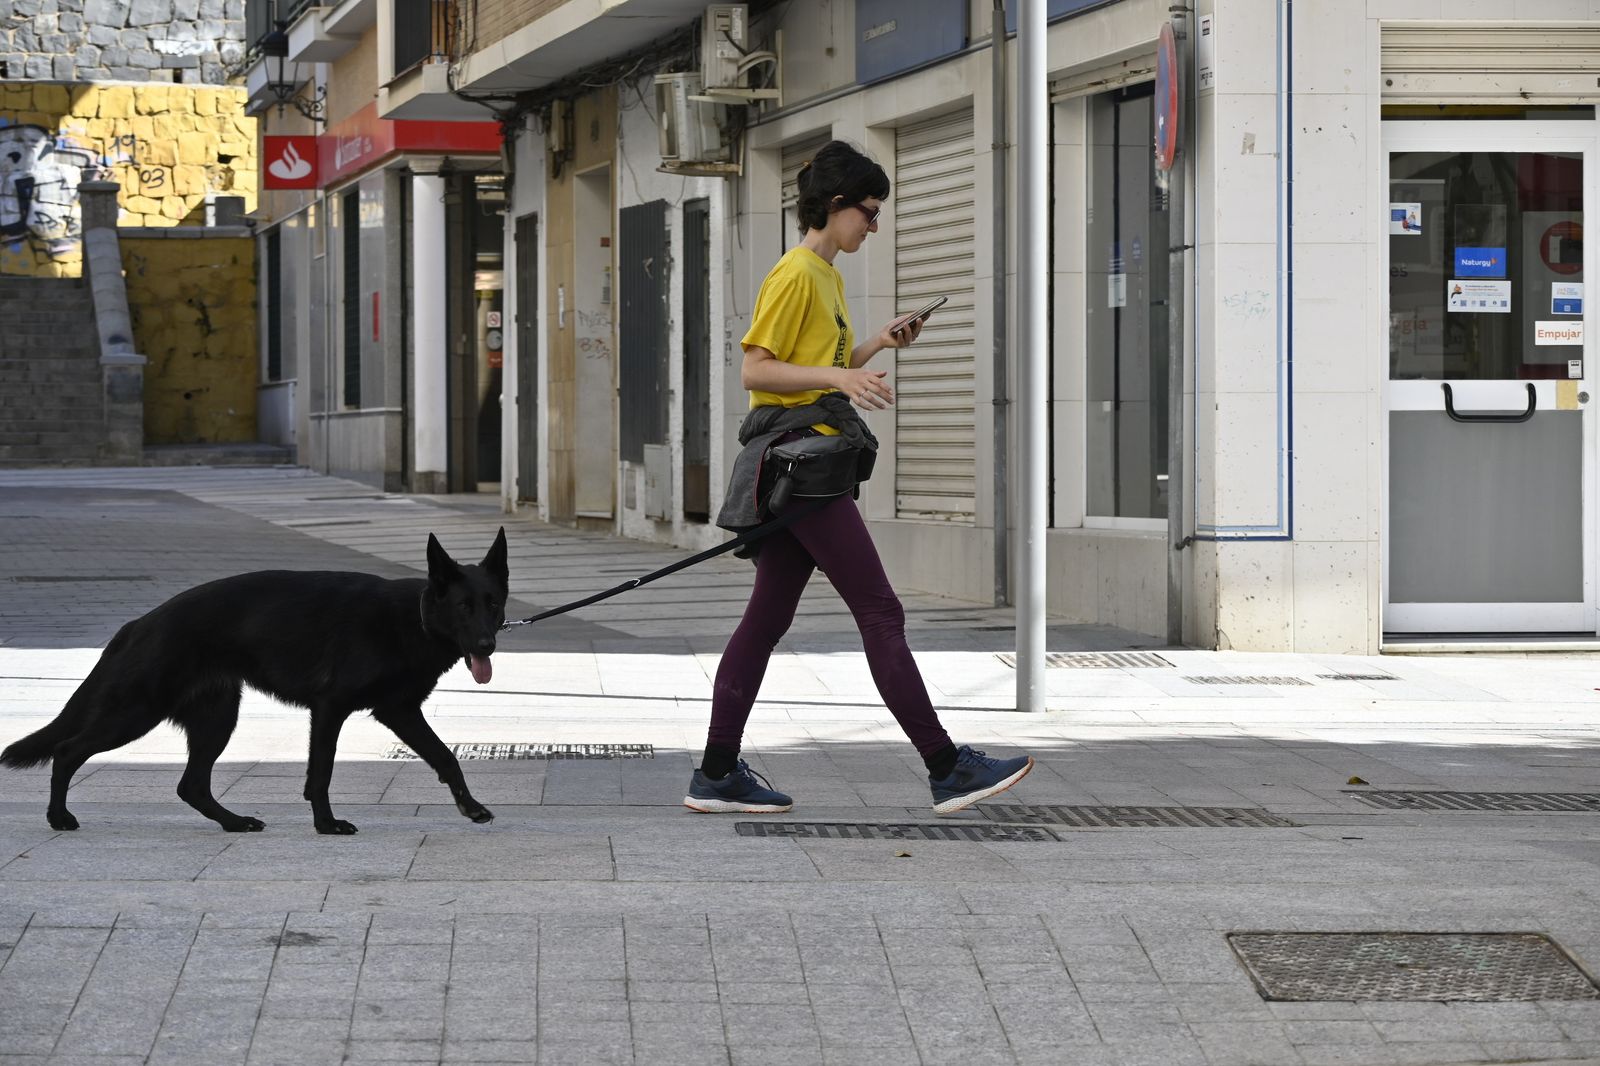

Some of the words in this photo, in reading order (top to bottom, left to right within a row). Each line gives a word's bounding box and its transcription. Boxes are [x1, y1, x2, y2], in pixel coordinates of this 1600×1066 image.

[140, 168, 164, 189] 03
[1461, 259, 1491, 267] Naturgy
[1537, 328, 1582, 340] Empujar
